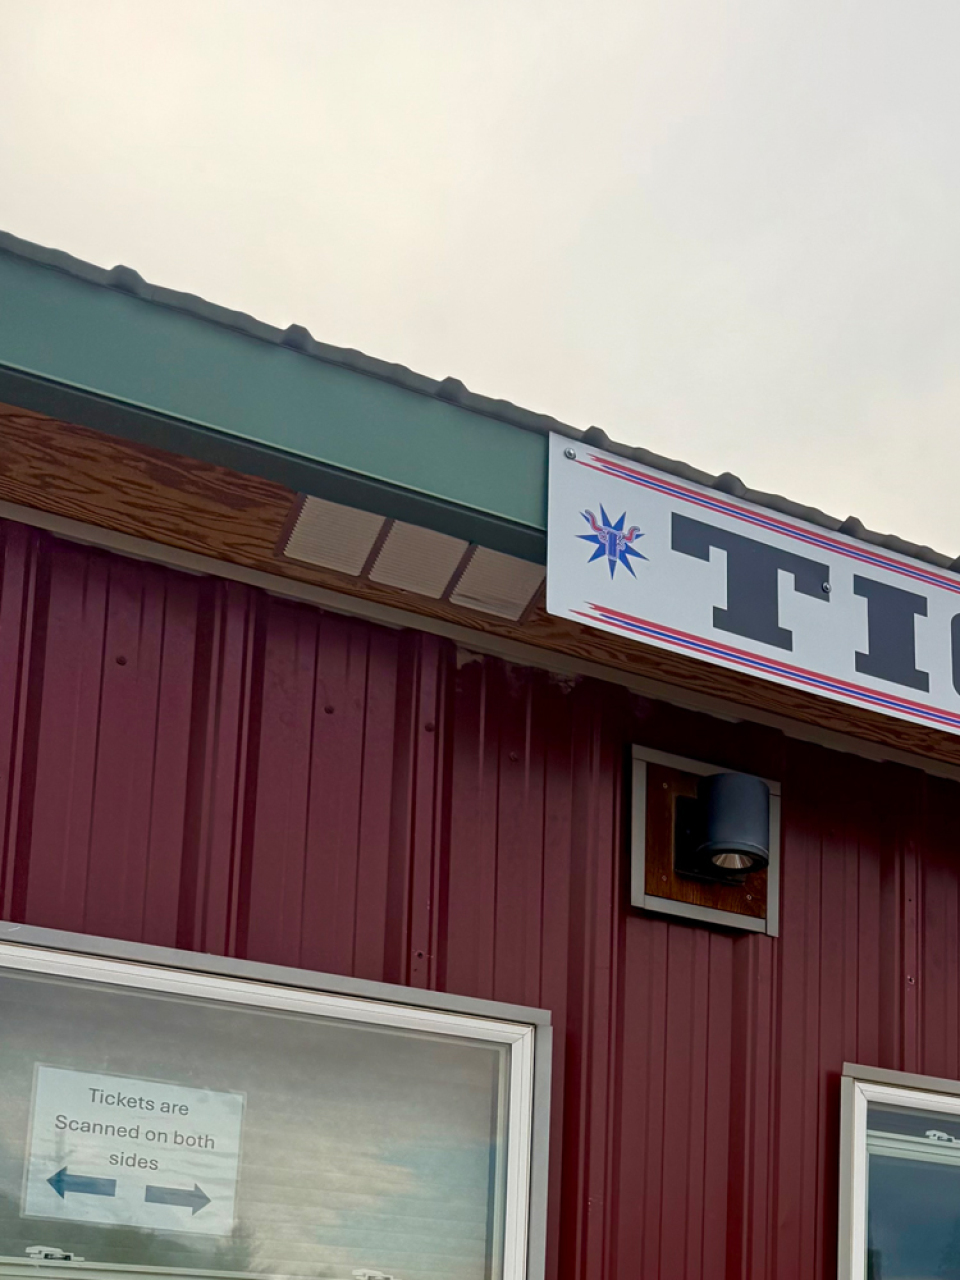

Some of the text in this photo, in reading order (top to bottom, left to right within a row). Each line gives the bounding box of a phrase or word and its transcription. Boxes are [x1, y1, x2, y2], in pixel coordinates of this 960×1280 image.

[89, 1087, 189, 1116] Tickets are
[54, 1114, 215, 1149] Scanned on both
[108, 1152, 159, 1171] sides
